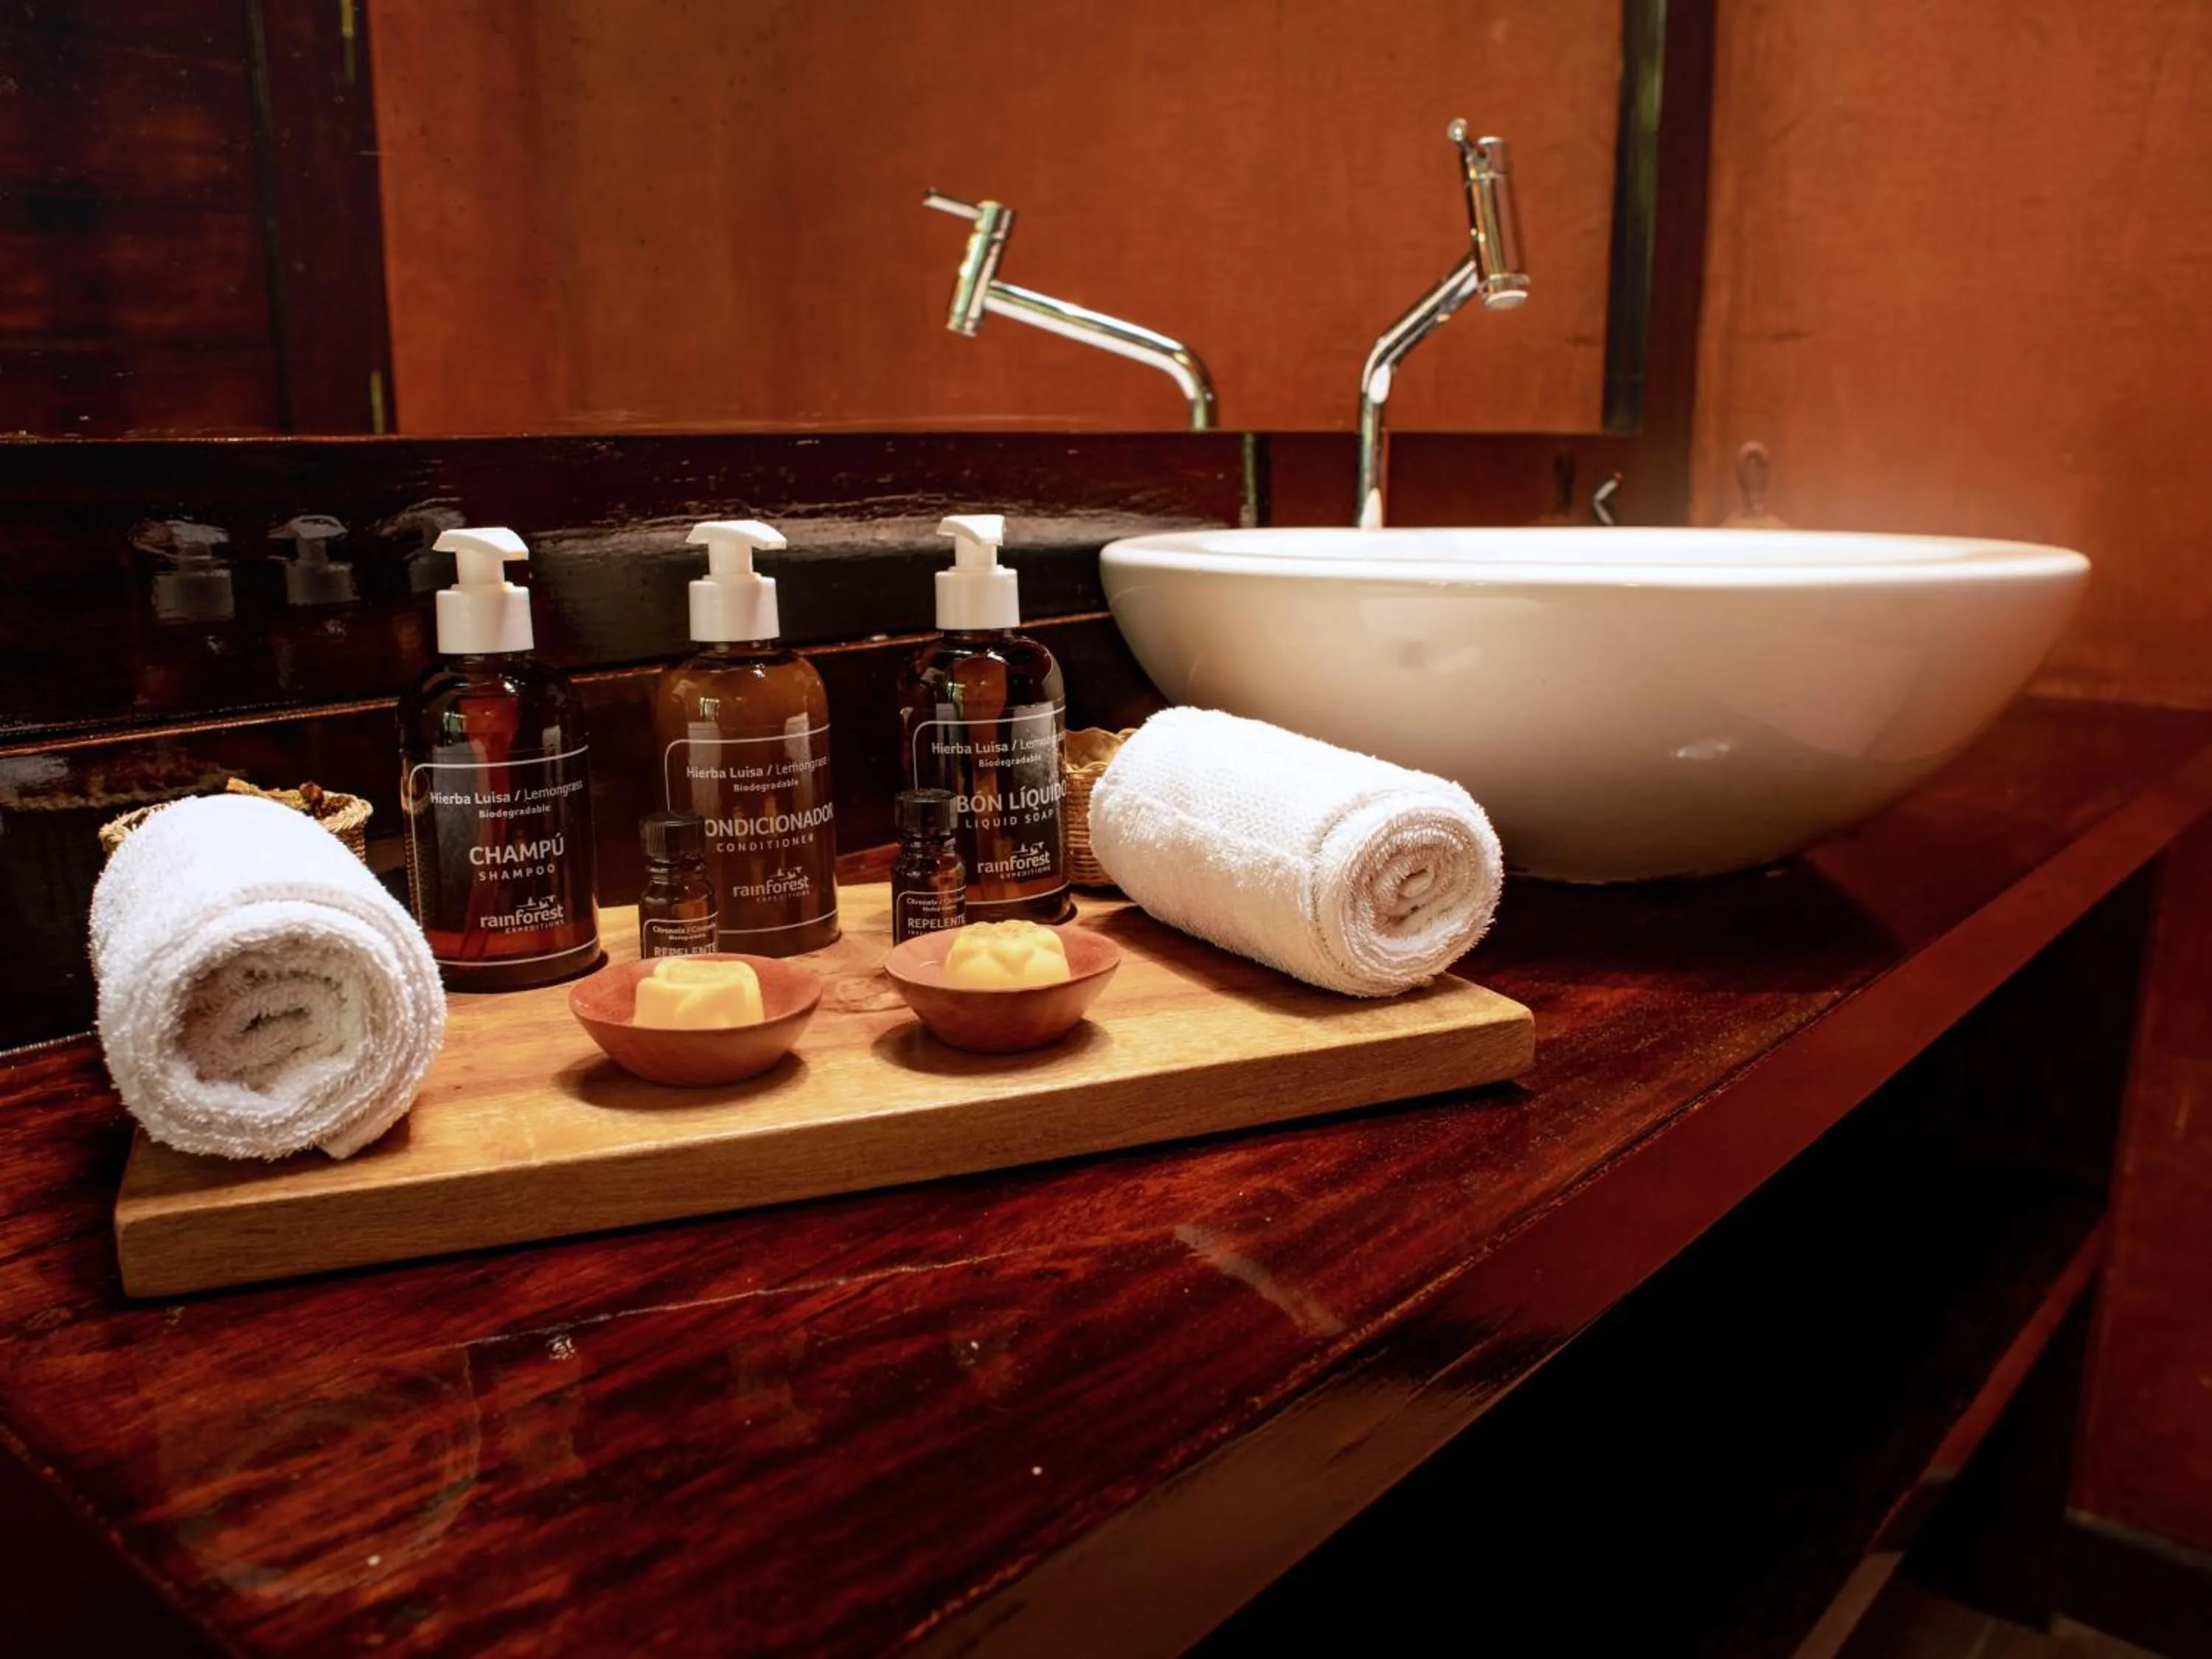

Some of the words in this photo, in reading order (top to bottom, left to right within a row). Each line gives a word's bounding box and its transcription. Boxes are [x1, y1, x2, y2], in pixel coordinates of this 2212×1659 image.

[931, 742, 972, 754] Hierba
[975, 741, 1009, 754] Luisa
[1011, 740, 1017, 751] /
[978, 754, 1041, 768] Biodegradable
[686, 766, 726, 779] Hierba
[730, 766, 763, 778] Luisa
[767, 764, 773, 776] /
[430, 792, 471, 804] Hierba
[474, 790, 511, 804] Luisa
[514, 790, 521, 801] /
[524, 779, 583, 801] Lemongrass
[734, 779, 799, 793] Biodegradable
[956, 790, 1002, 813] BÓN
[1009, 780, 1066, 810] LÍQUIDO
[479, 804, 552, 818] Biodegradable
[704, 802, 834, 837] ONDICIONADOR
[965, 816, 1018, 830] LIQUID
[1024, 809, 1054, 824] SOAP
[469, 832, 565, 865] CHAMPÚ
[717, 833, 814, 852] CONDITIONER
[479, 863, 555, 881] SHAMPOO
[977, 851, 1051, 874] rainforest
[733, 875, 809, 897] rainforest
[480, 904, 564, 928] rainforest
[908, 912, 966, 929] REPELENTE
[654, 942, 717, 956] REPELENTE
